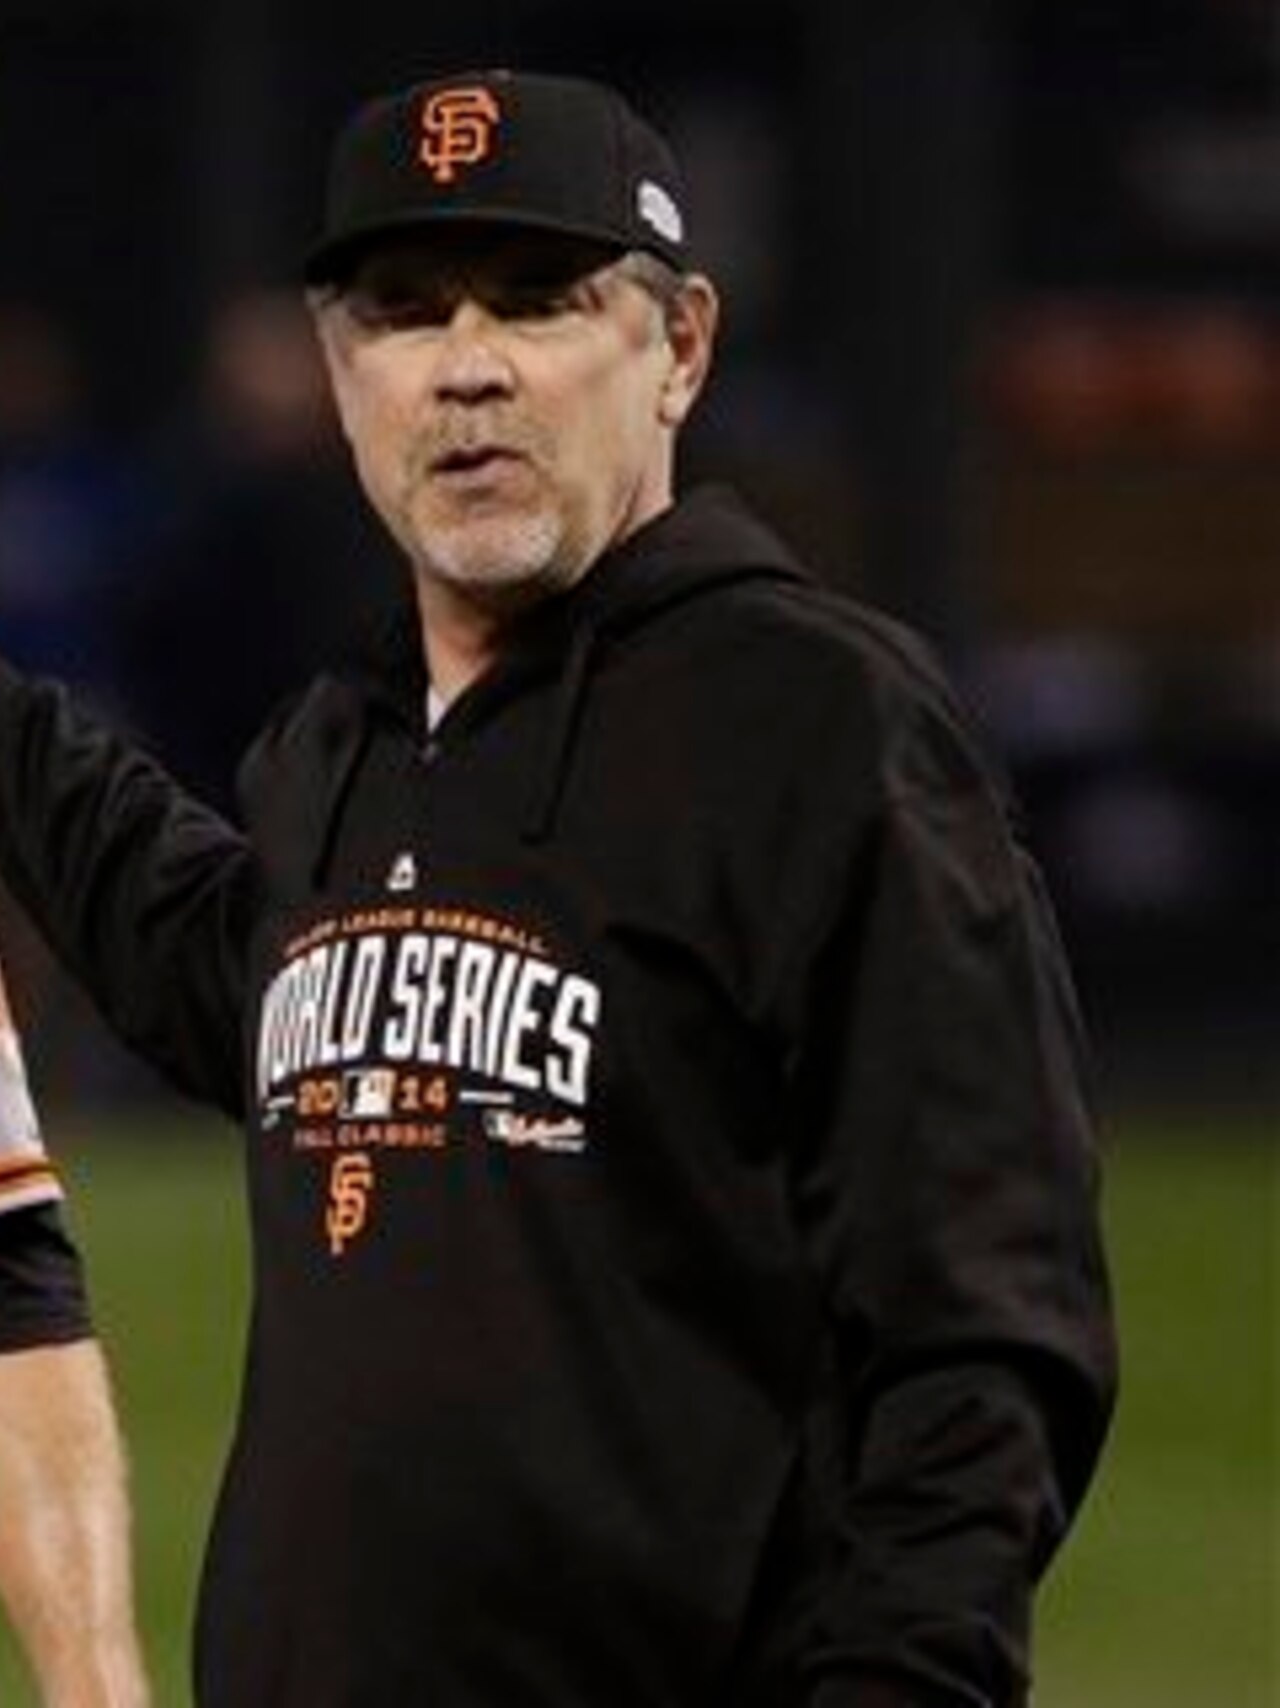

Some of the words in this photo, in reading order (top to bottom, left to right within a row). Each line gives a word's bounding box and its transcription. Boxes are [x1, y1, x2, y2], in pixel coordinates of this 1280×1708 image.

[422, 86, 500, 183] SF
[384, 934, 602, 1107] SERIES
[399, 1076, 448, 1112] 14
[326, 1152, 374, 1255] SF
